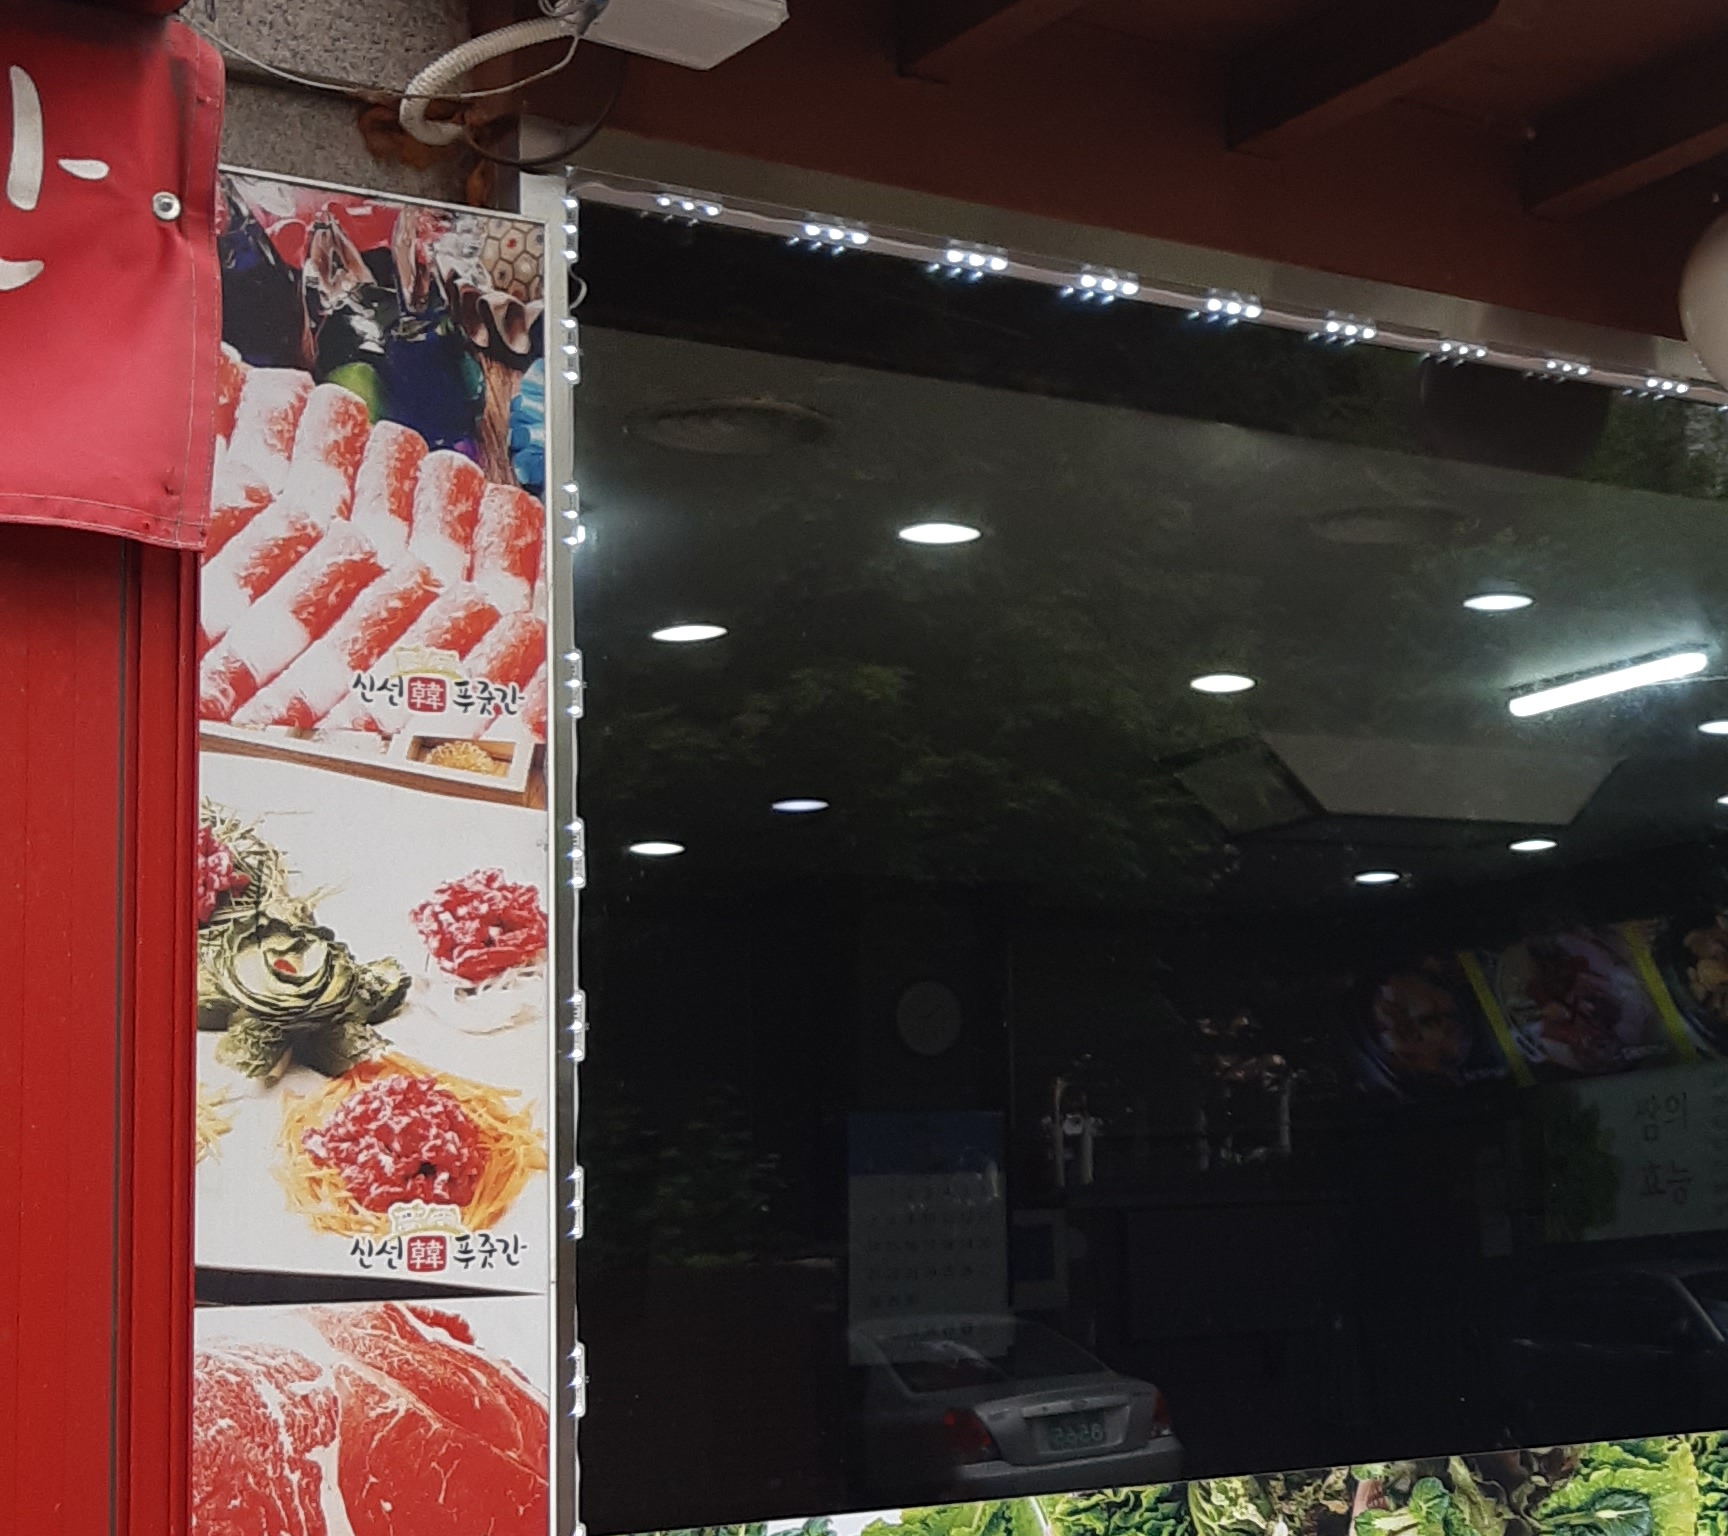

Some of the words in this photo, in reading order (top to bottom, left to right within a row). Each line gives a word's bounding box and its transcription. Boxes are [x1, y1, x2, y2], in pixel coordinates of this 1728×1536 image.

[352, 673, 403, 707] 신선
[452, 679, 526, 715] 푸줏간
[350, 1234, 403, 1270] 신선
[453, 1232, 528, 1270] 푸줏간
